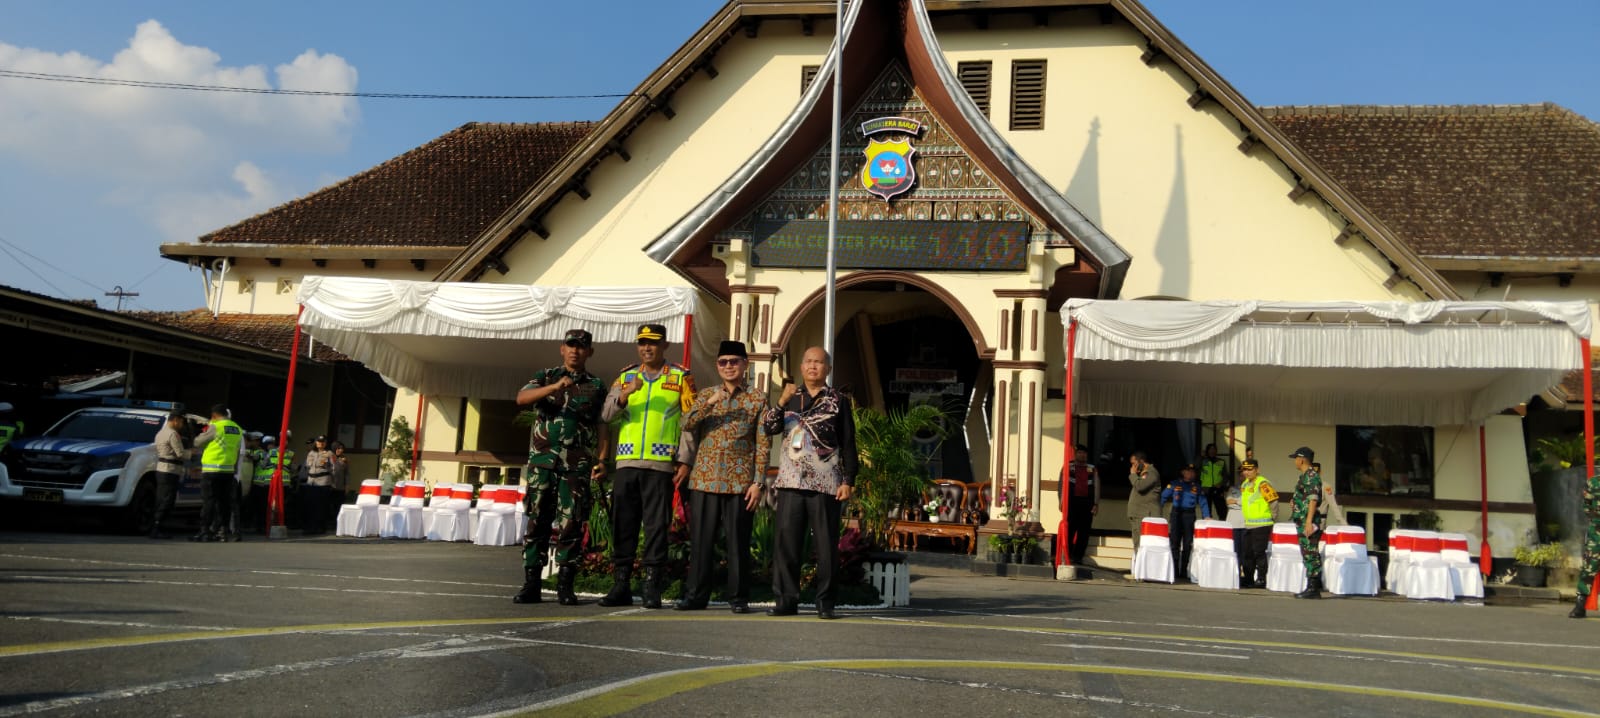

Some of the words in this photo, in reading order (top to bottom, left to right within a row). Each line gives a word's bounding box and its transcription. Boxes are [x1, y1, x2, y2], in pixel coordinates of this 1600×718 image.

[897, 120, 918, 130] BARAT
[768, 235, 802, 249] CALL
[807, 235, 865, 249] CETER
[869, 235, 917, 250] POLRI
